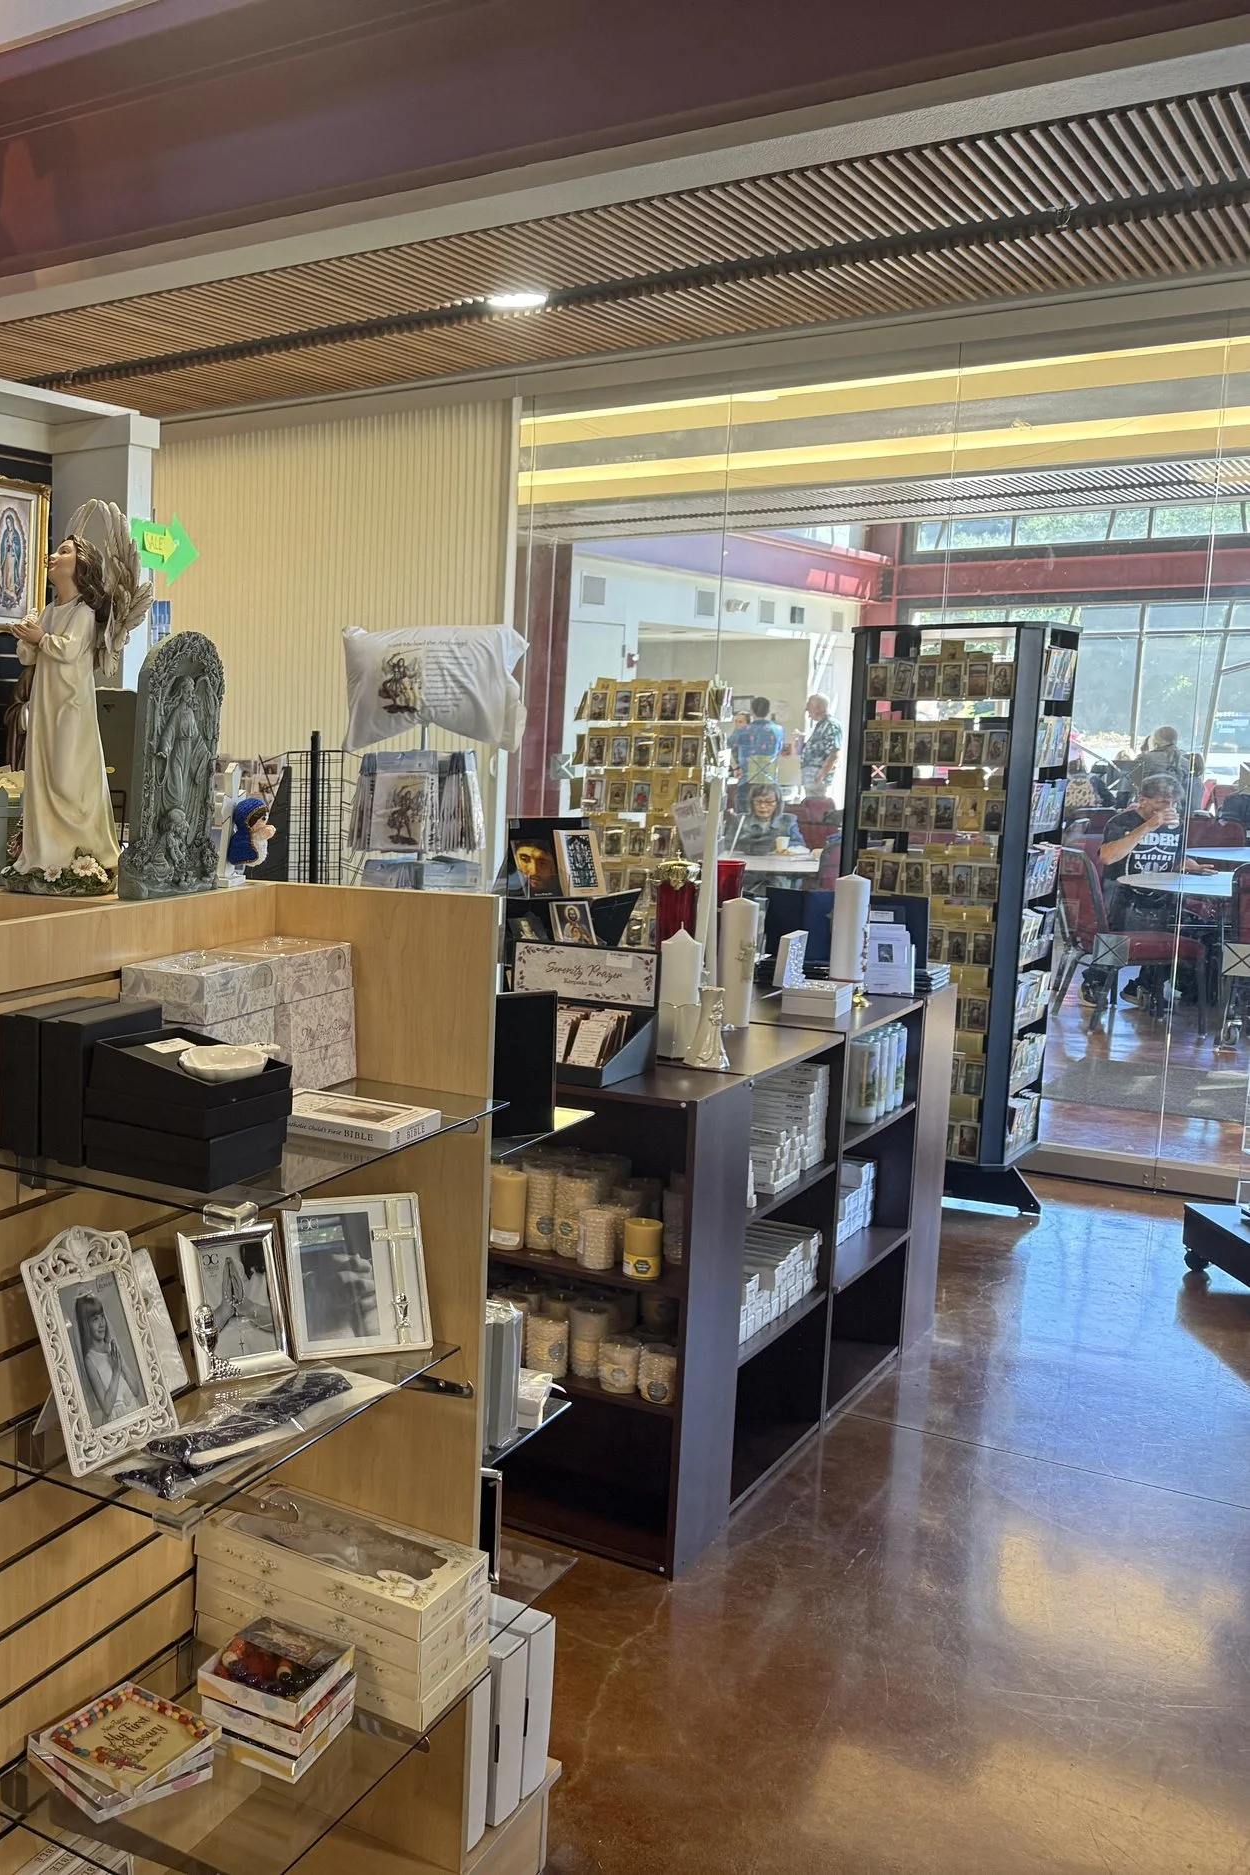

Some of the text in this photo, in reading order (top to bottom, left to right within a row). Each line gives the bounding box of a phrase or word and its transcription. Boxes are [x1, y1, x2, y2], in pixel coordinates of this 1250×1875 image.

[145, 532, 165, 551] SALE
[1136, 832, 1181, 847] IDERS
[1134, 853, 1173, 862] RAIDERS
[545, 960, 624, 984] Serenity Prayer
[563, 977, 603, 988] Keepsake Block
[287, 1121, 374, 1142] atholic Child's First BIBLE
[406, 1124, 426, 1140] BIBLE
[102, 1731, 128, 1752] My
[118, 1714, 151, 1733] First
[122, 1723, 169, 1749] Rosary
[34, 1844, 59, 1863] IBLE
[49, 1853, 76, 1873] IBLE
